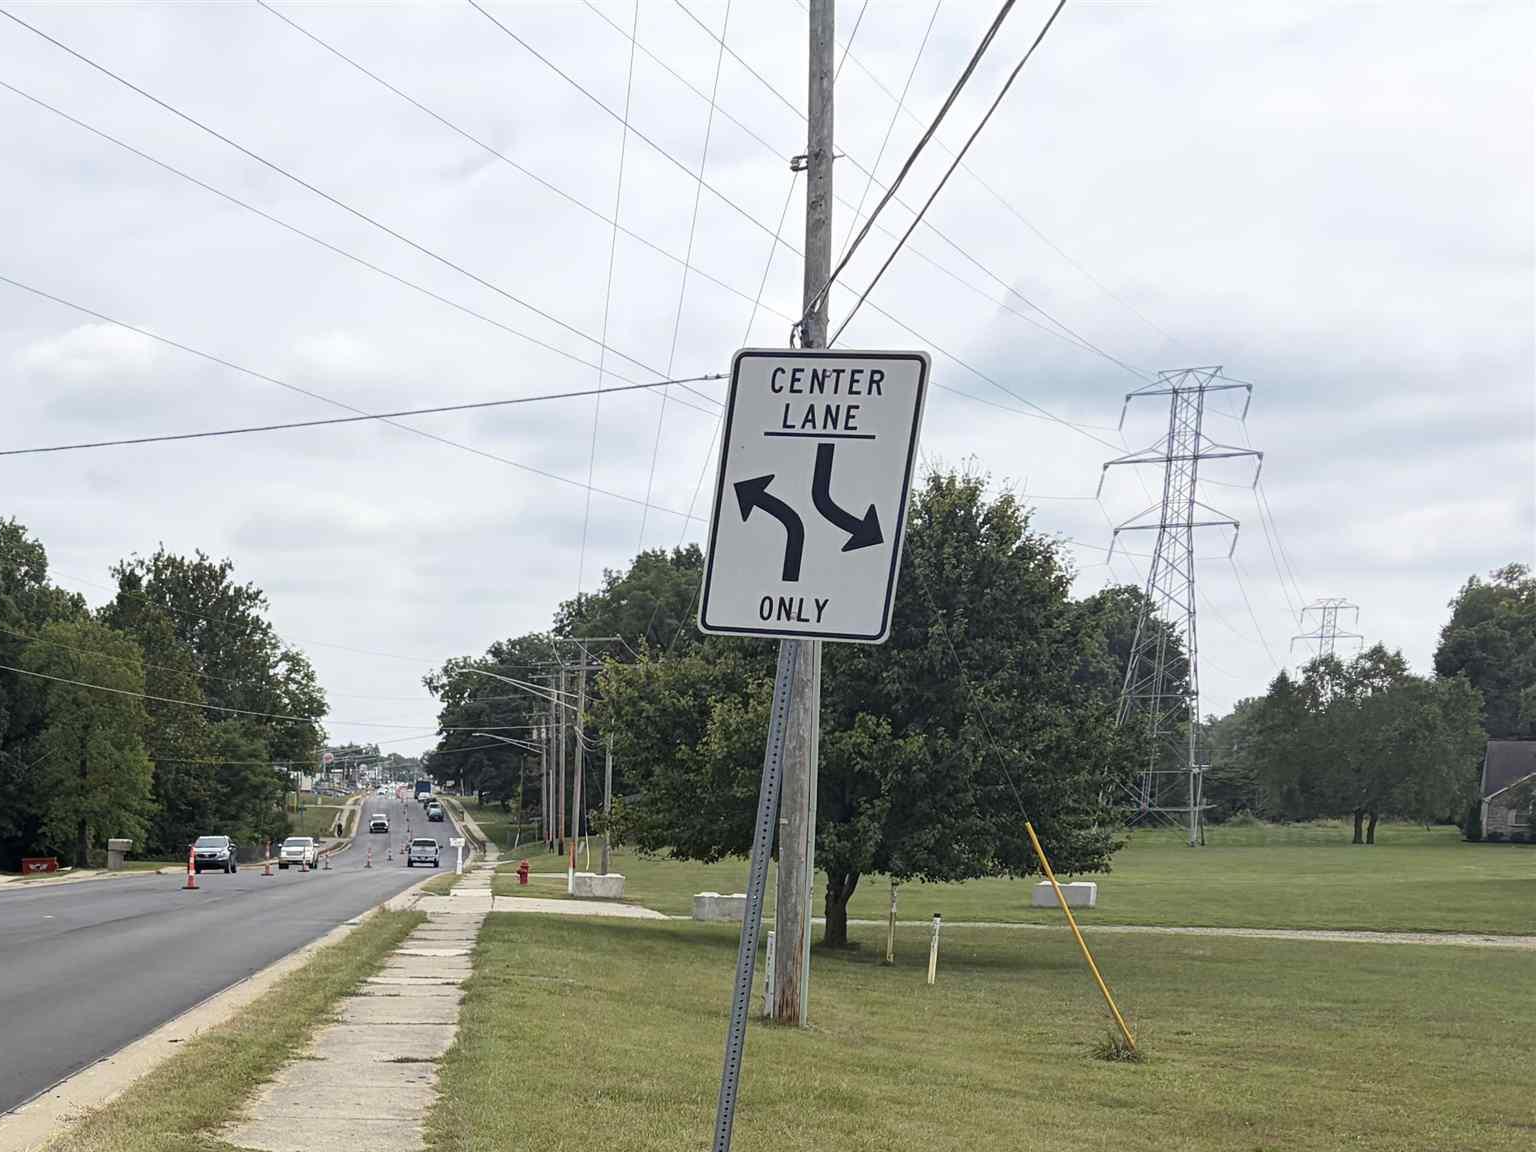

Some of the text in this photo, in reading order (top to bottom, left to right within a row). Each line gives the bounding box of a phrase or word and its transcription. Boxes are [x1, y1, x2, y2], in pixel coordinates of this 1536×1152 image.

[770, 367, 886, 396] CENTER
[782, 403, 860, 431] LANE
[759, 595, 830, 623] ONLY
